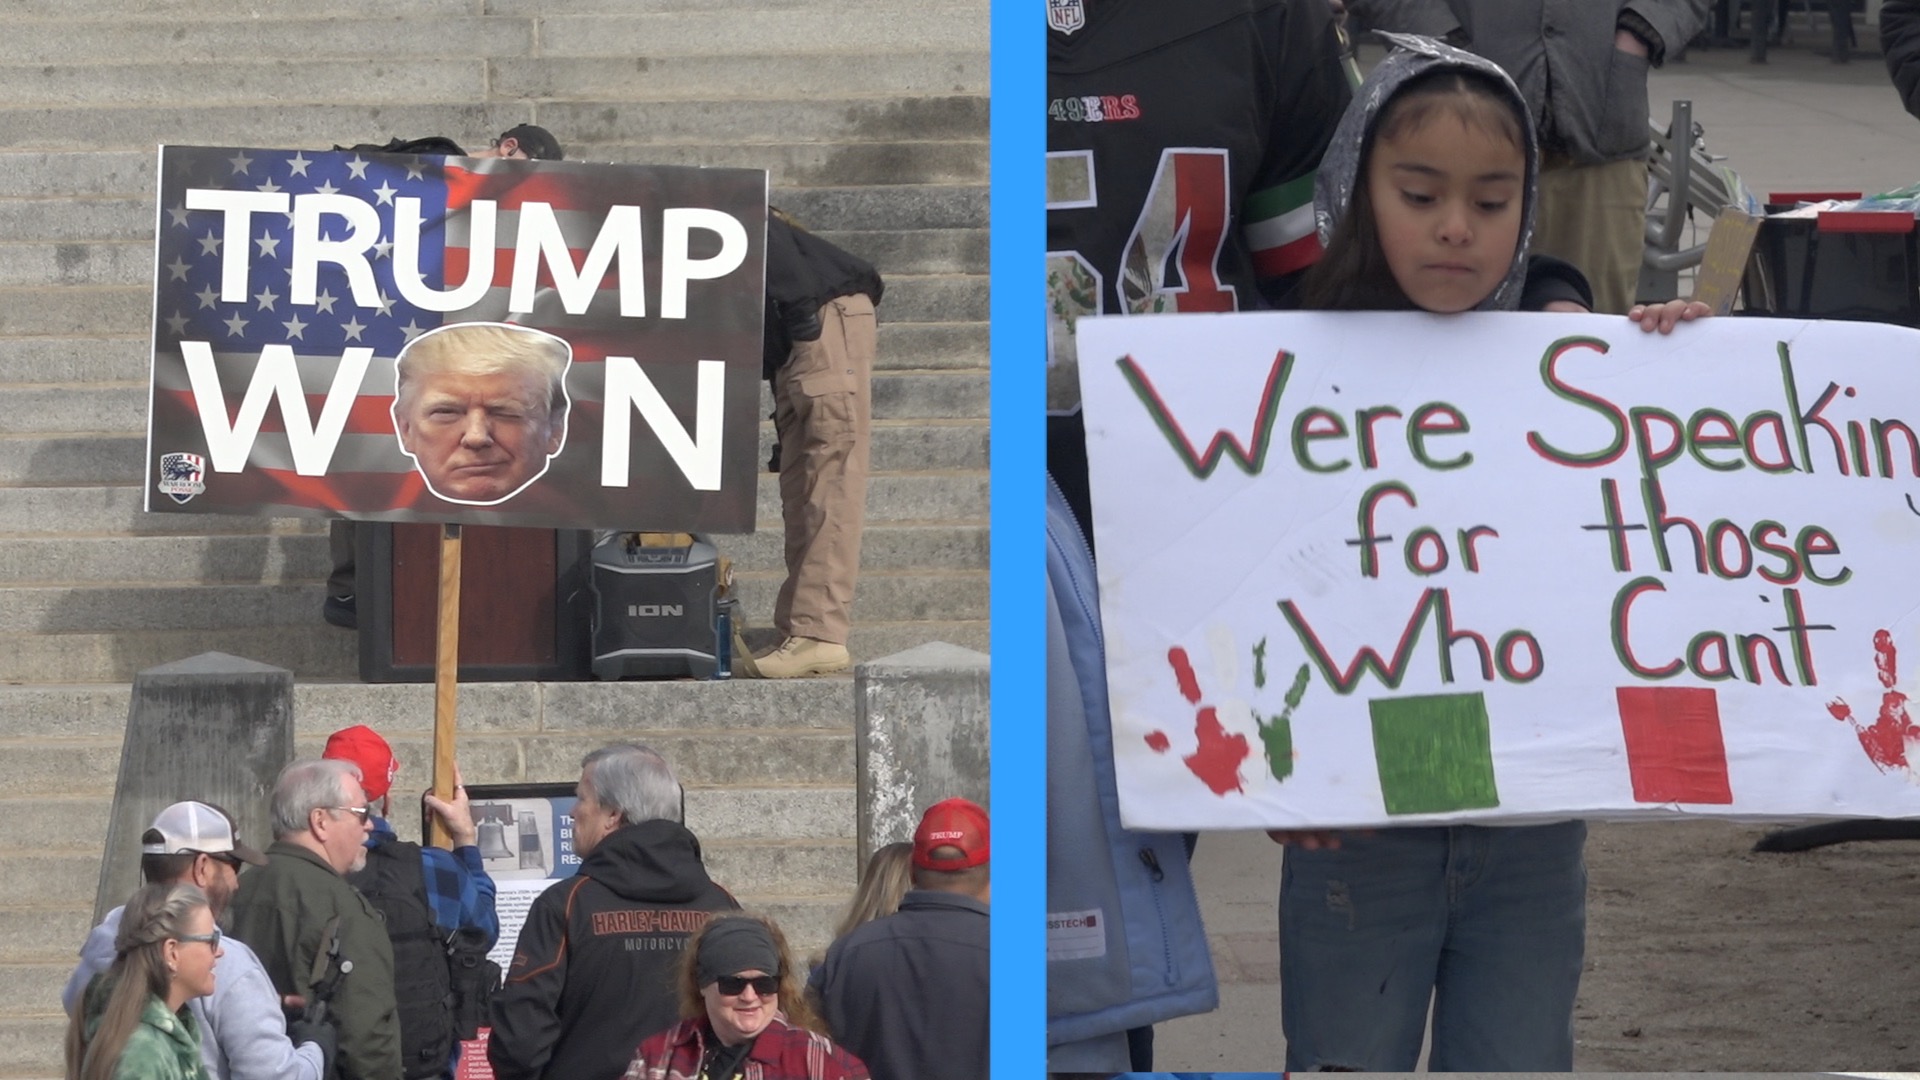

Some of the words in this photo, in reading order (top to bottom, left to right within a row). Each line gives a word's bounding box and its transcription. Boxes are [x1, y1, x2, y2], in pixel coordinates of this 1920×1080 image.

[1054, 7, 1080, 26] NFL
[1048, 94, 1141, 122] 49ERS
[186, 188, 749, 320] TRUMP
[1115, 348, 1474, 481] We're
[1526, 334, 1920, 516] Speakin
[1345, 480, 1499, 578] for
[1581, 478, 1853, 586] those
[628, 605, 684, 617] ION
[1278, 587, 1544, 695] Who
[1611, 576, 1837, 687] Can't
[931, 831, 963, 840] TRUMP
[1048, 917, 1087, 929] SSTECH
